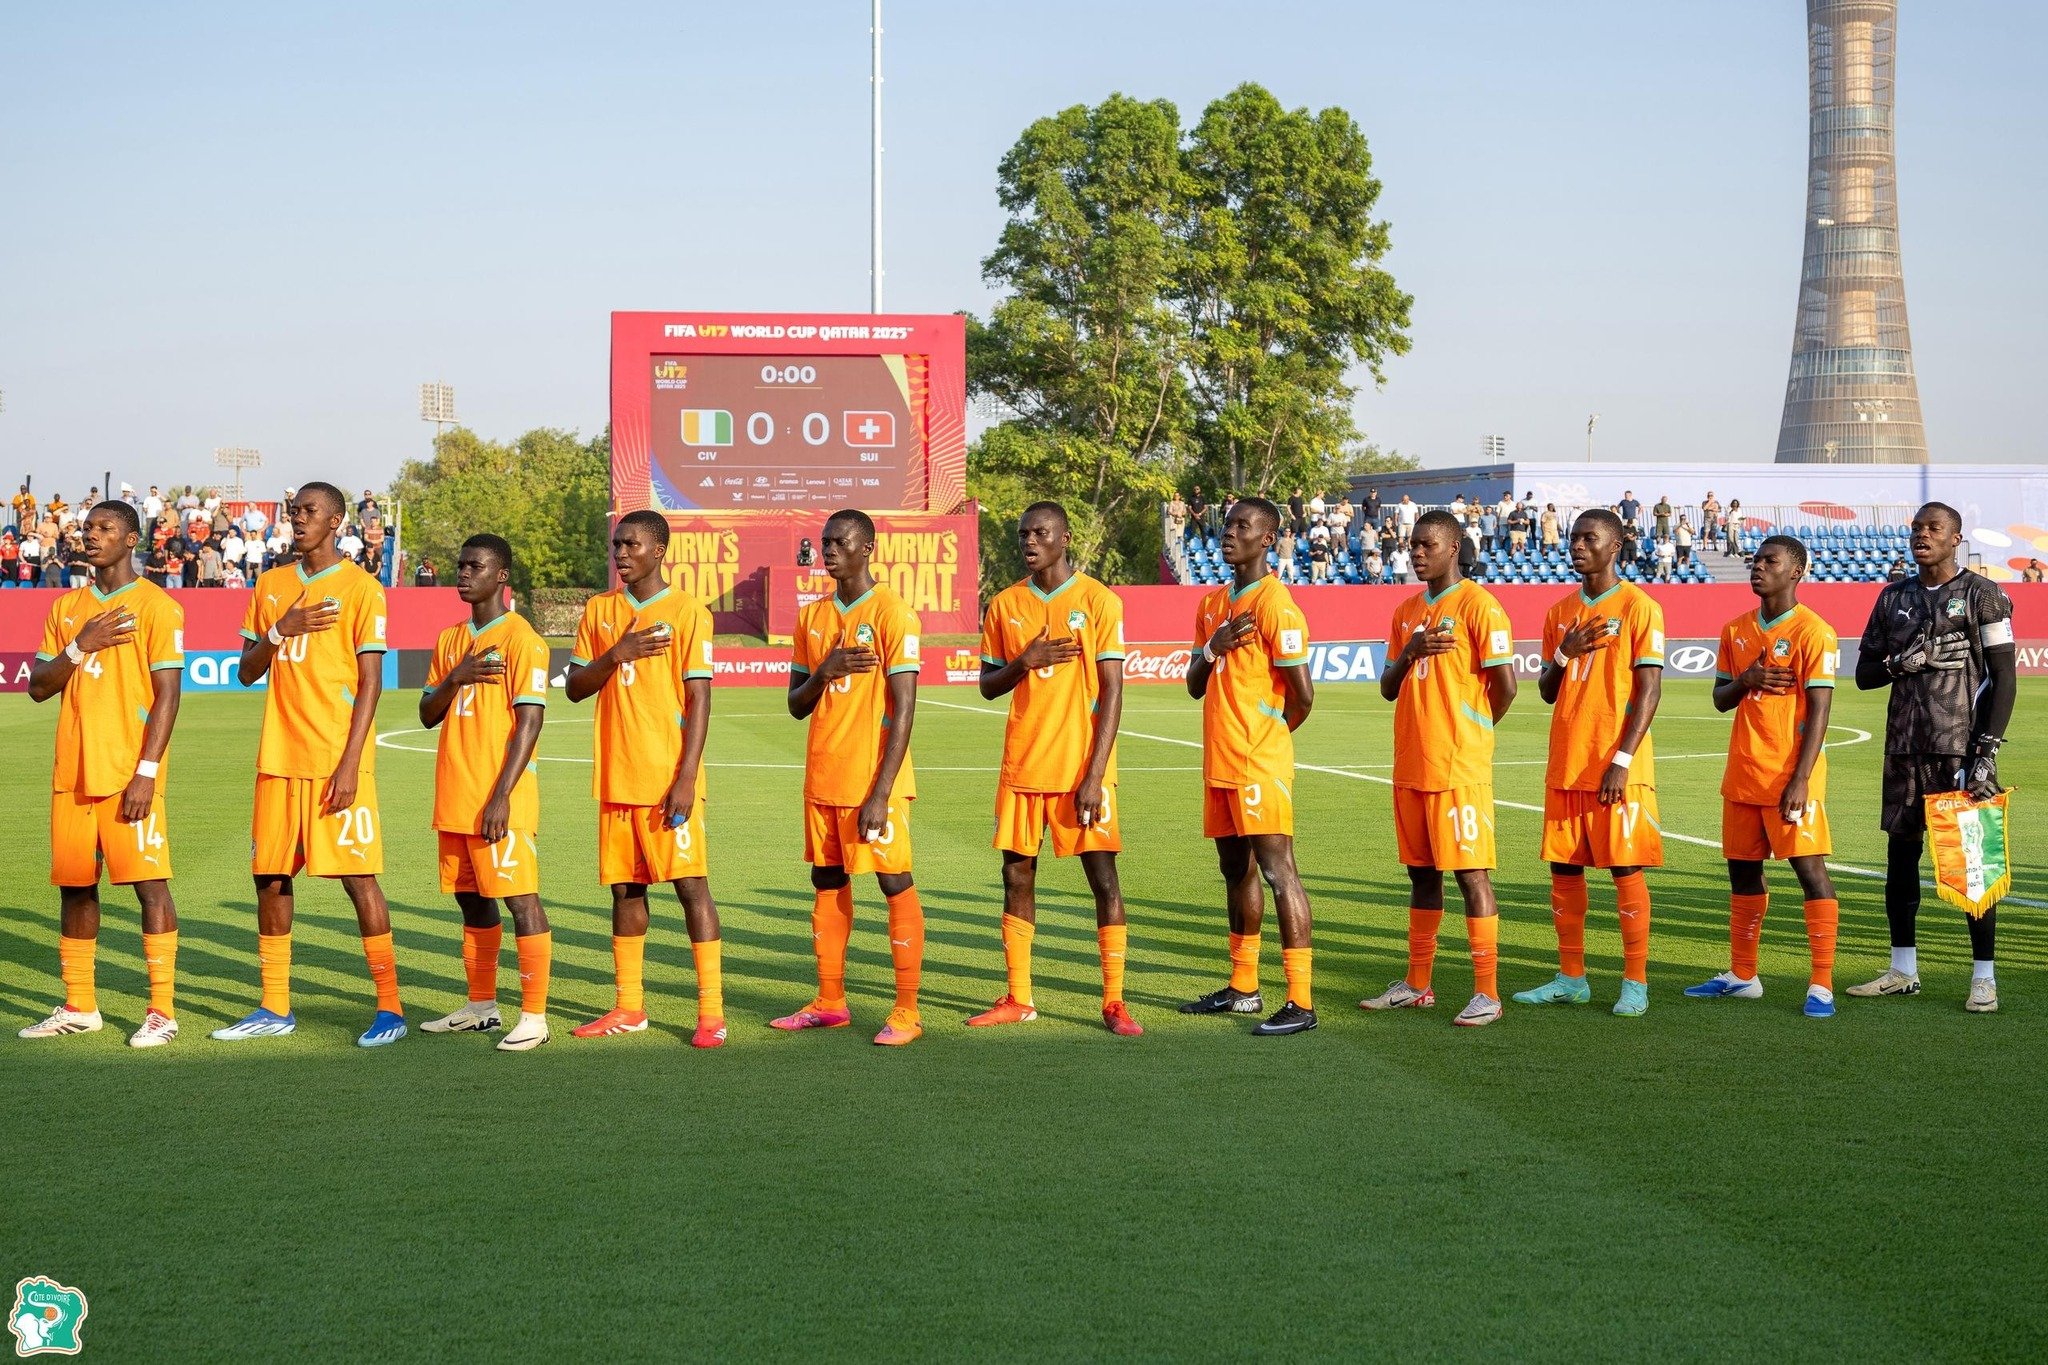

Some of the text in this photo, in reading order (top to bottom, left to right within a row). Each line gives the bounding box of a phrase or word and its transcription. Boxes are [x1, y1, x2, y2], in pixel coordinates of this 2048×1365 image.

[664, 325, 697, 337] FIFA
[698, 325, 728, 337] U17
[731, 326, 785, 338] WORLD
[787, 326, 817, 338] CUP
[819, 327, 869, 341] QATAR
[761, 365, 816, 384] 0:00
[747, 412, 774, 446] 0
[803, 412, 830, 446] 0
[698, 452, 717, 461] CIV
[860, 453, 879, 462] SUI
[861, 478, 879, 486] VISA
[662, 528, 739, 563] MRW'S
[736, 662, 763, 673] U-17
[130, 811, 164, 852] 14
[336, 806, 374, 846] 20
[1447, 805, 1479, 843] 18
[1616, 801, 1640, 839] 17
[491, 829, 518, 868] 12
